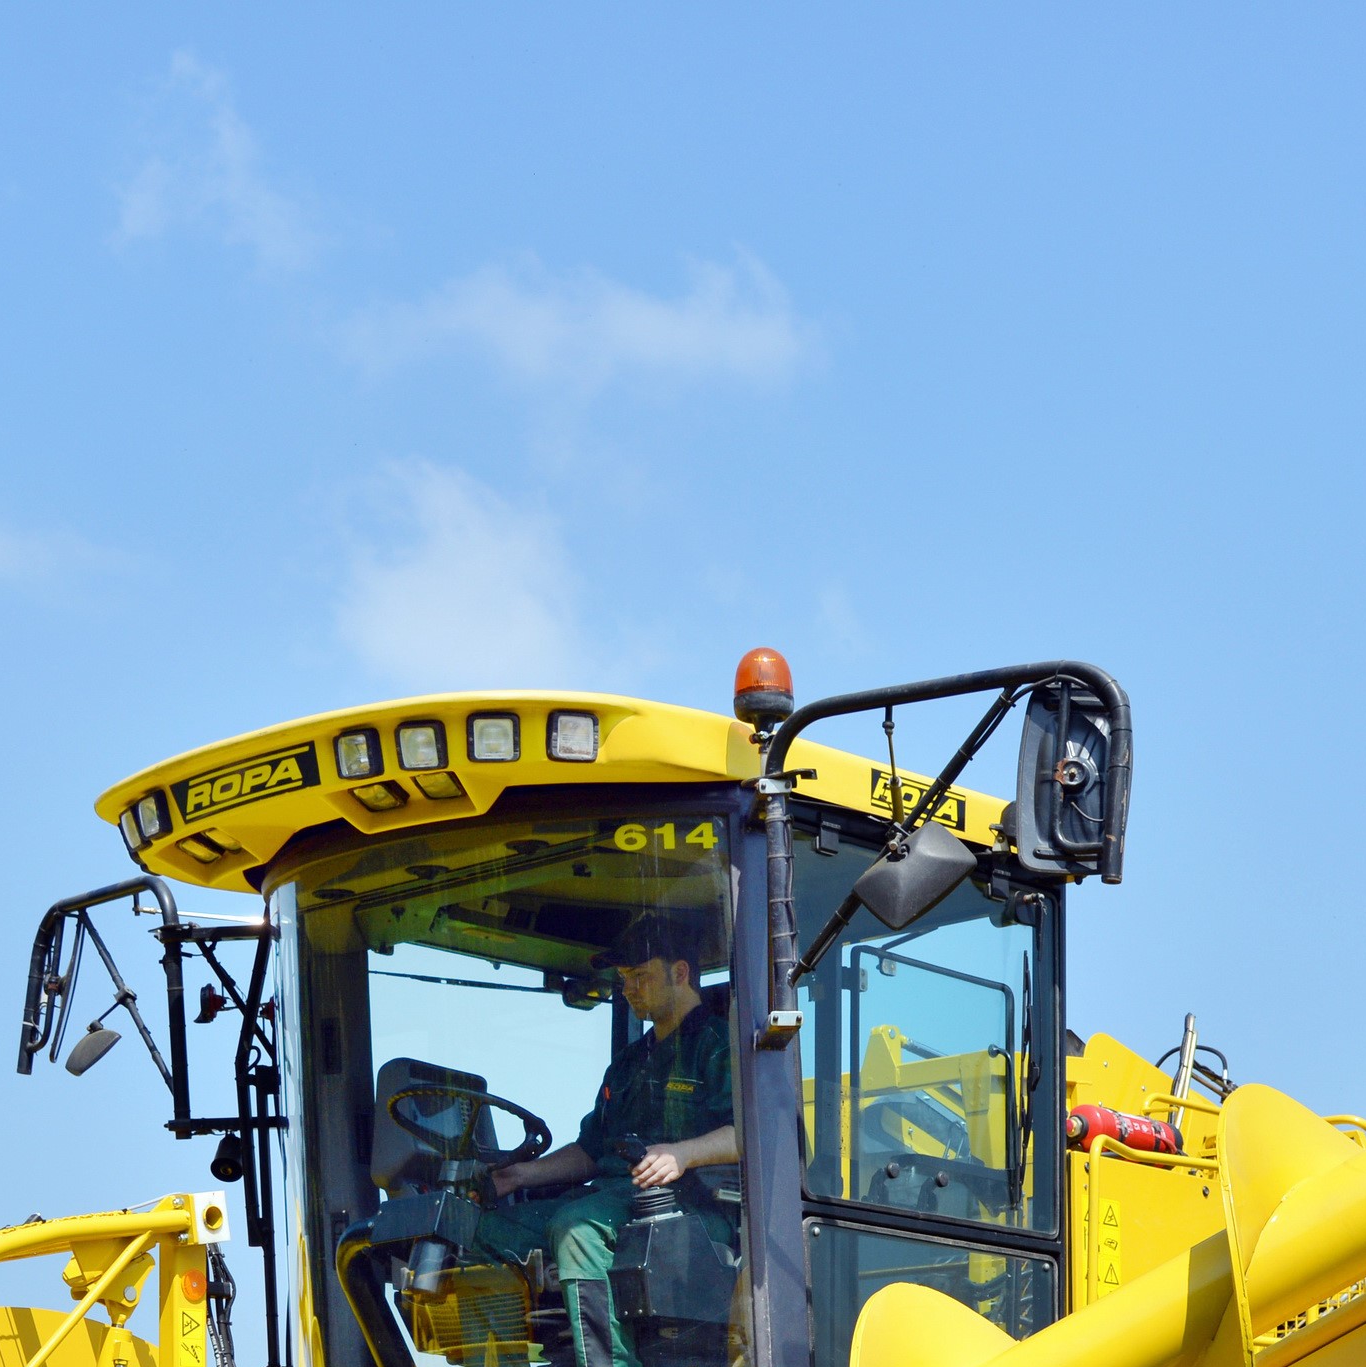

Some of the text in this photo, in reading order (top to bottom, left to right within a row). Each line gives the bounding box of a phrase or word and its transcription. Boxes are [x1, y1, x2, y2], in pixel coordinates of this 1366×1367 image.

[186, 756, 303, 813] ROPA
[872, 777, 958, 822] ROA
[614, 822, 719, 851] 614
